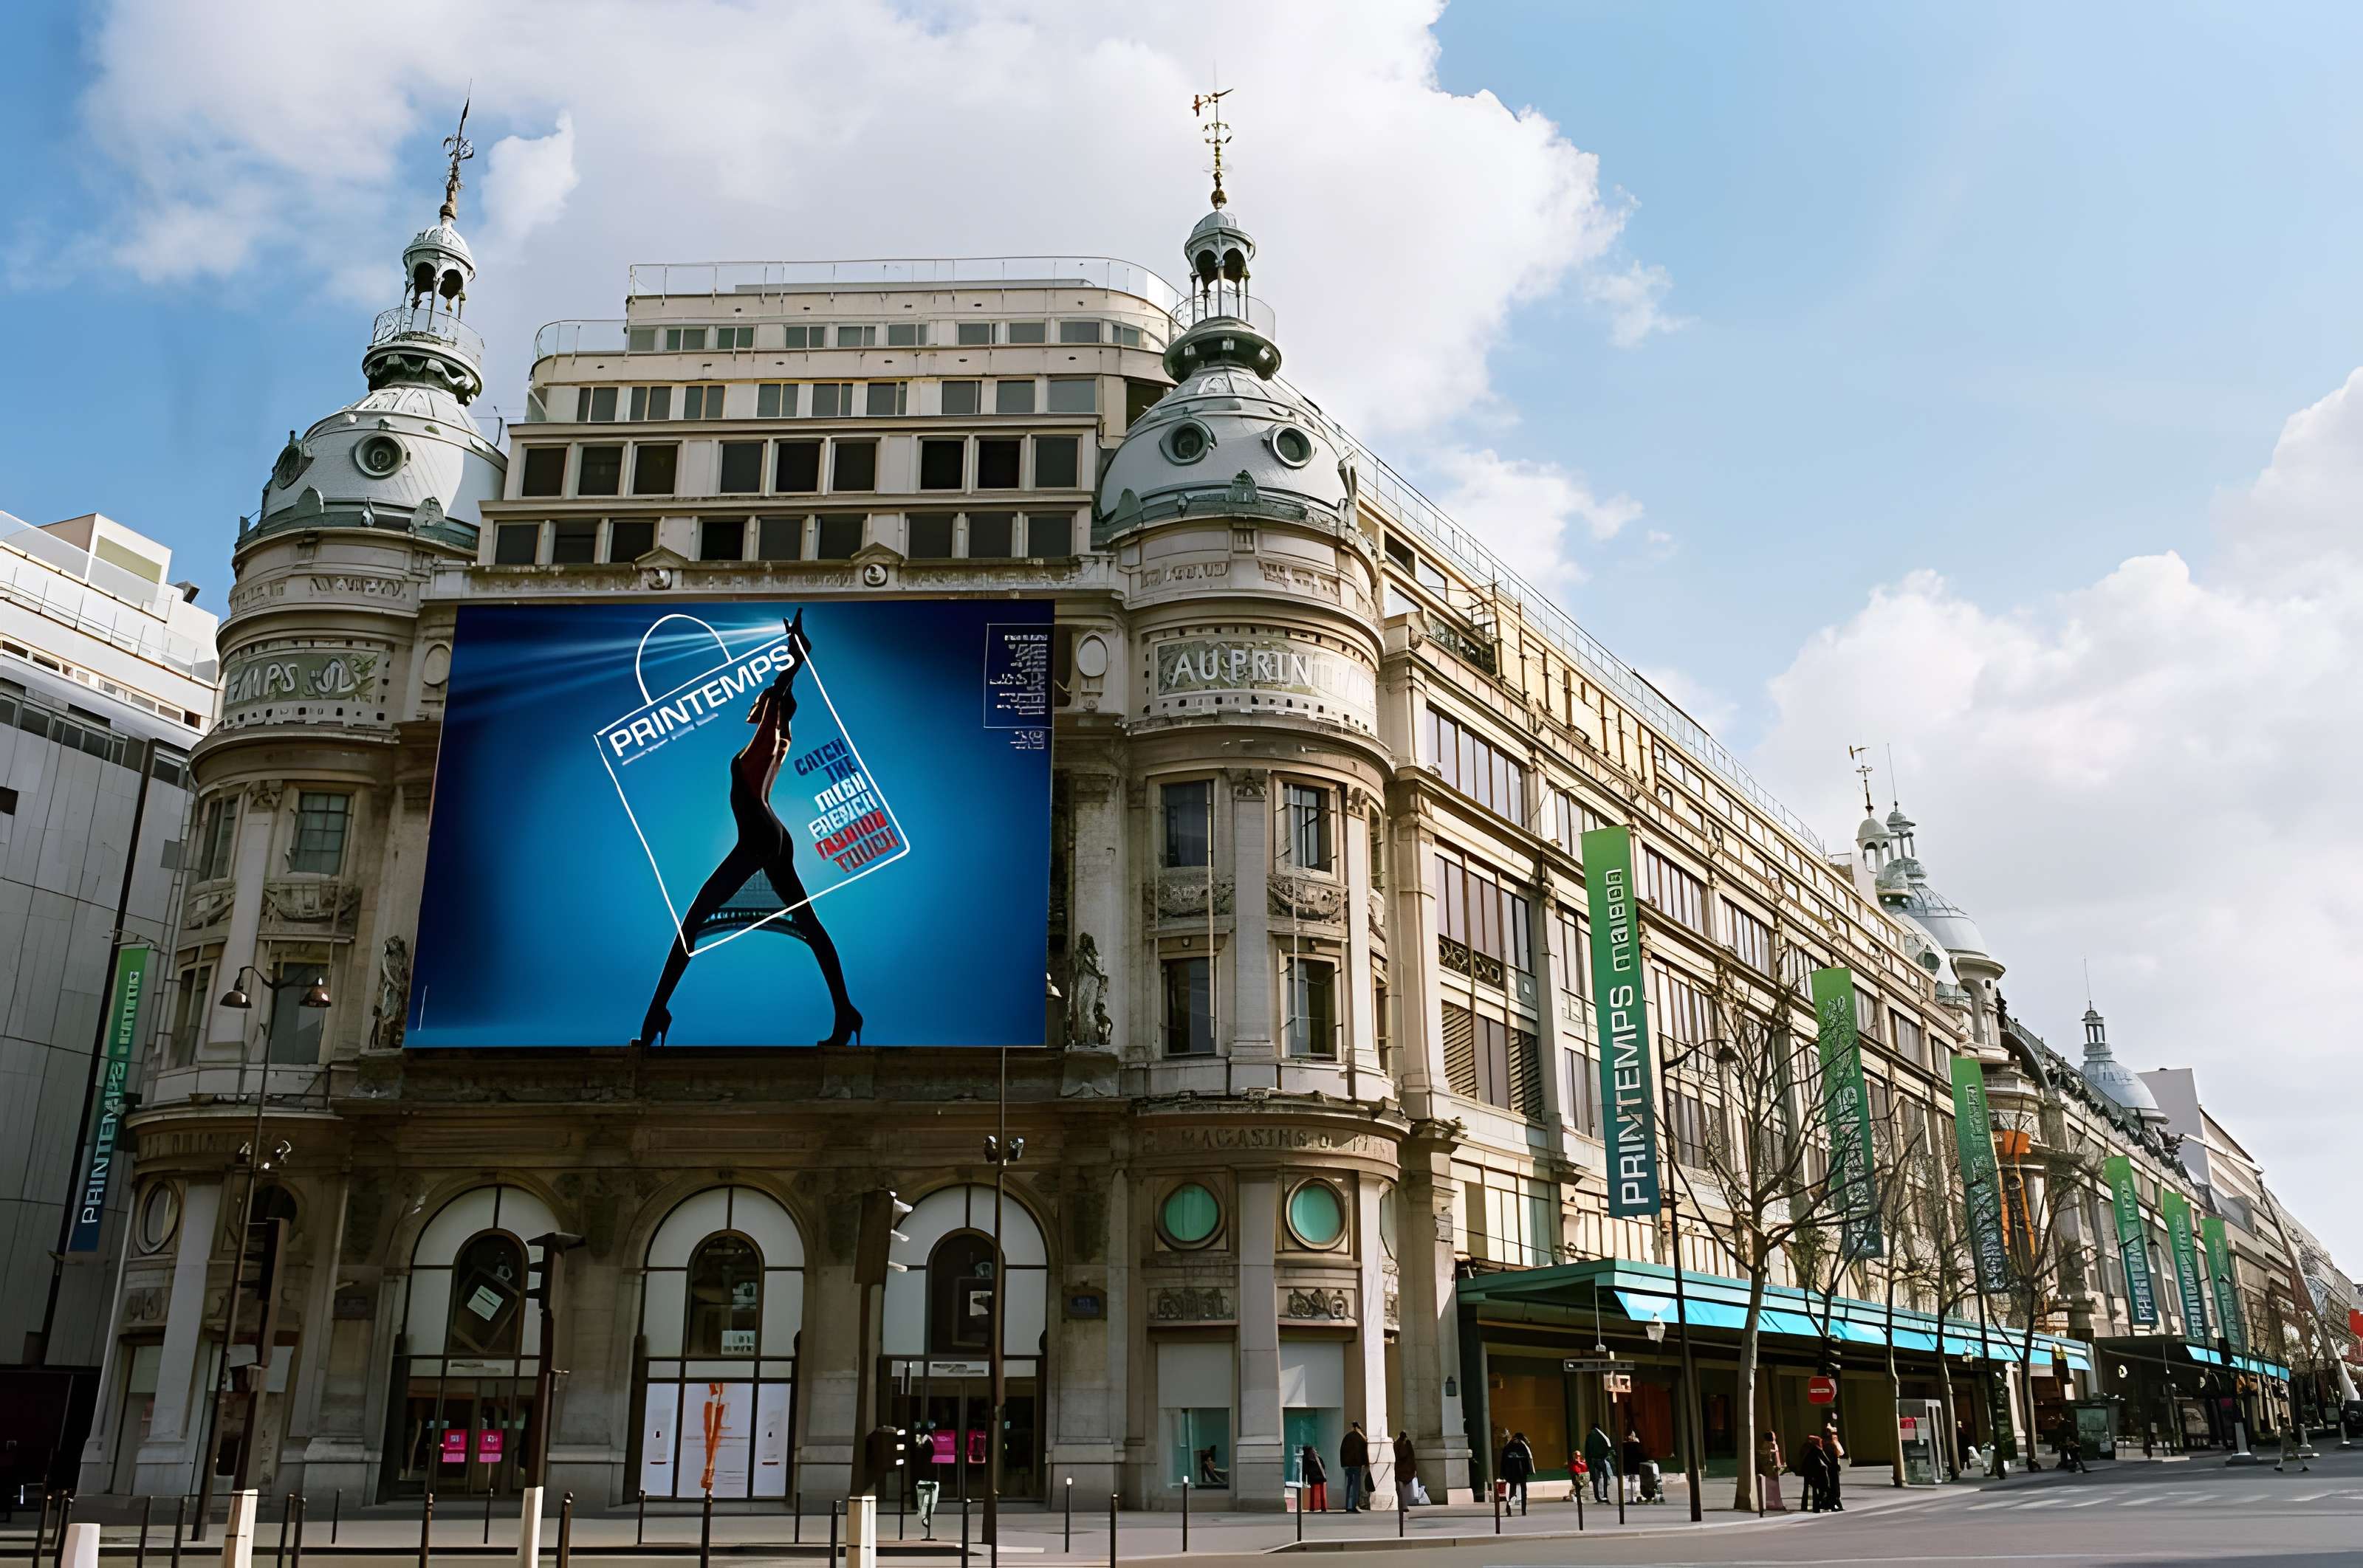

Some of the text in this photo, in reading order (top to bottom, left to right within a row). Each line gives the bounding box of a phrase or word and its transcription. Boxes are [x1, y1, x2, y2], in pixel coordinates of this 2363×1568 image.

[608, 645, 795, 757] PRINTEMPS
[1172, 648, 1219, 687] AU
[1610, 985, 1649, 1205] PRINTEMPS
